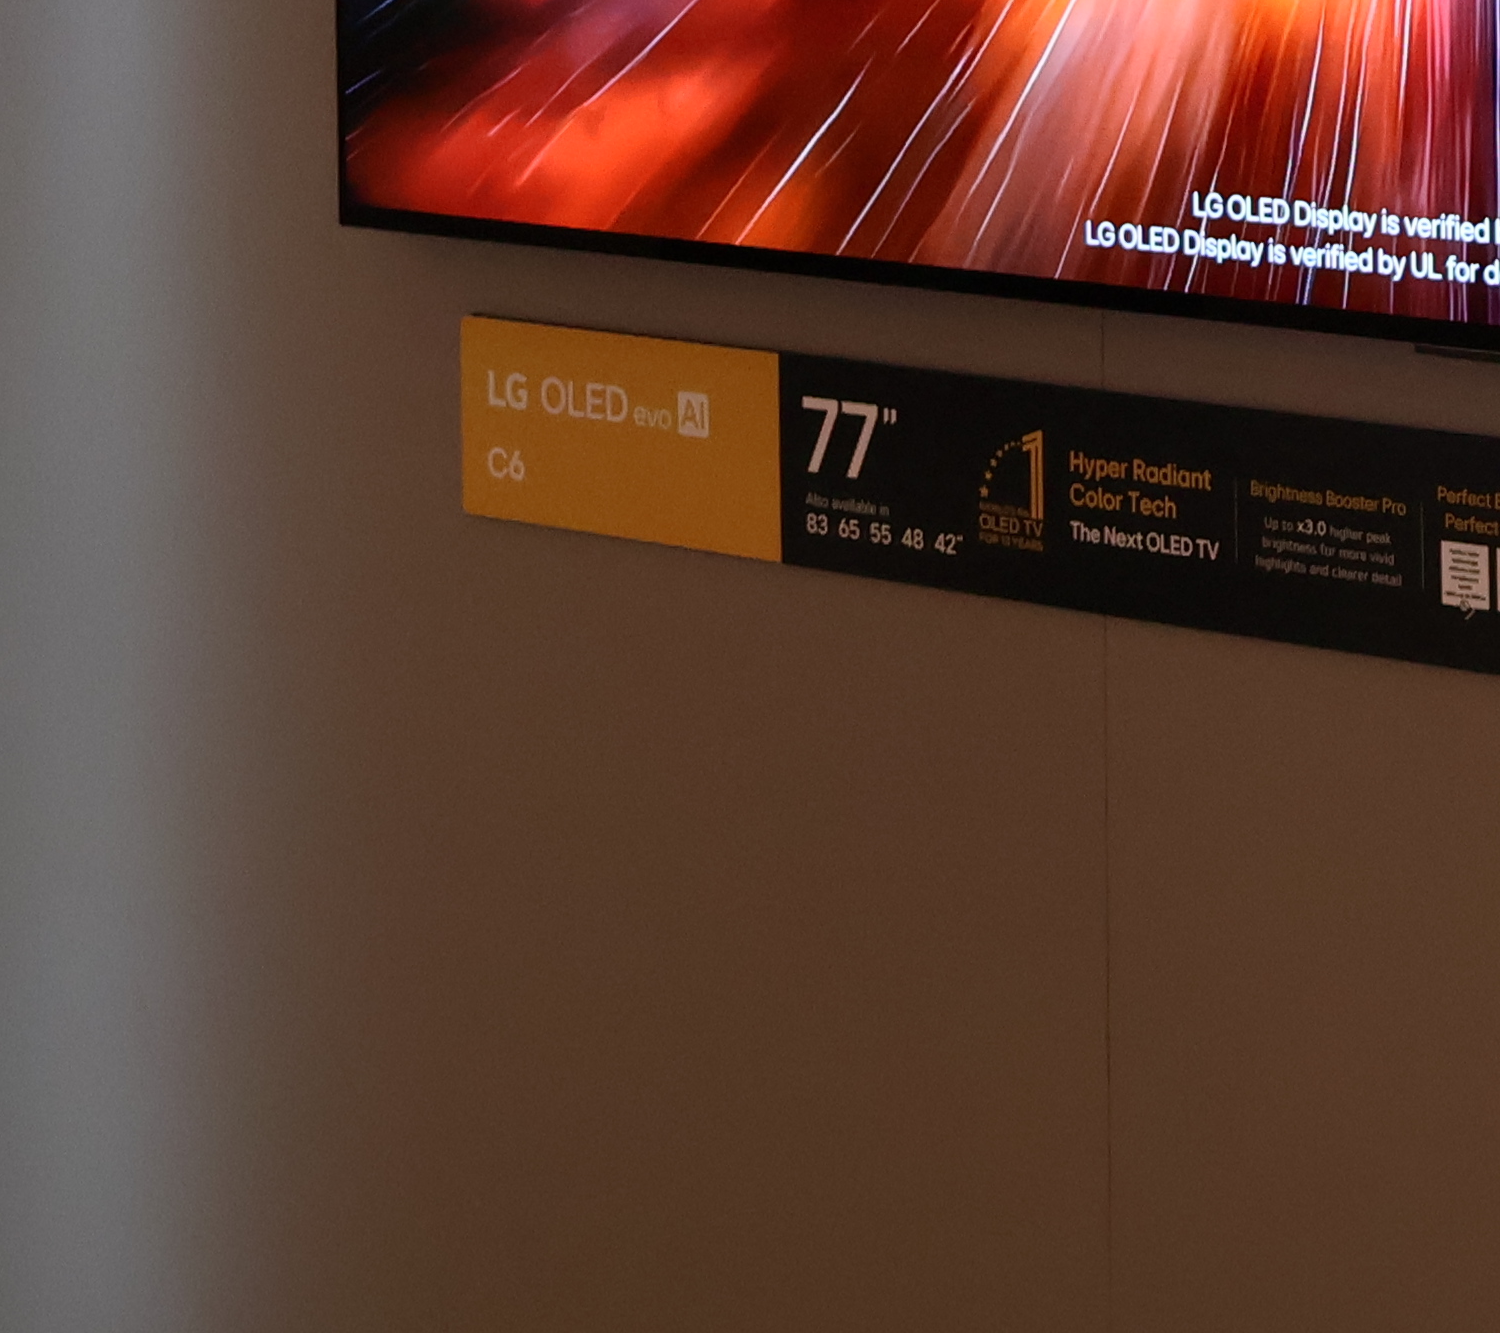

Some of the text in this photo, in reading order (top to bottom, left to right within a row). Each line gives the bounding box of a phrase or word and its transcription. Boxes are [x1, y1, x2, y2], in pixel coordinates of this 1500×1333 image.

[1192, 191, 1223, 218] LG
[1227, 193, 1290, 224] OLED
[1294, 199, 1376, 238] Display
[1381, 208, 1400, 235] is
[1404, 214, 1490, 244] verified
[488, 371, 706, 432] LG OLED evo AI
[488, 447, 525, 481] C6
[1070, 451, 1211, 491] Hyper Radiant
[1070, 483, 1176, 518] Color Tech
[807, 513, 828, 535] 83
[839, 519, 860, 539] 65
[870, 523, 891, 545] 55
[902, 528, 923, 549] 48
[1070, 521, 1100, 543] The
[1104, 526, 1143, 550] Next
[1146, 532, 1193, 556] OLED
[1196, 539, 1219, 560] TV
